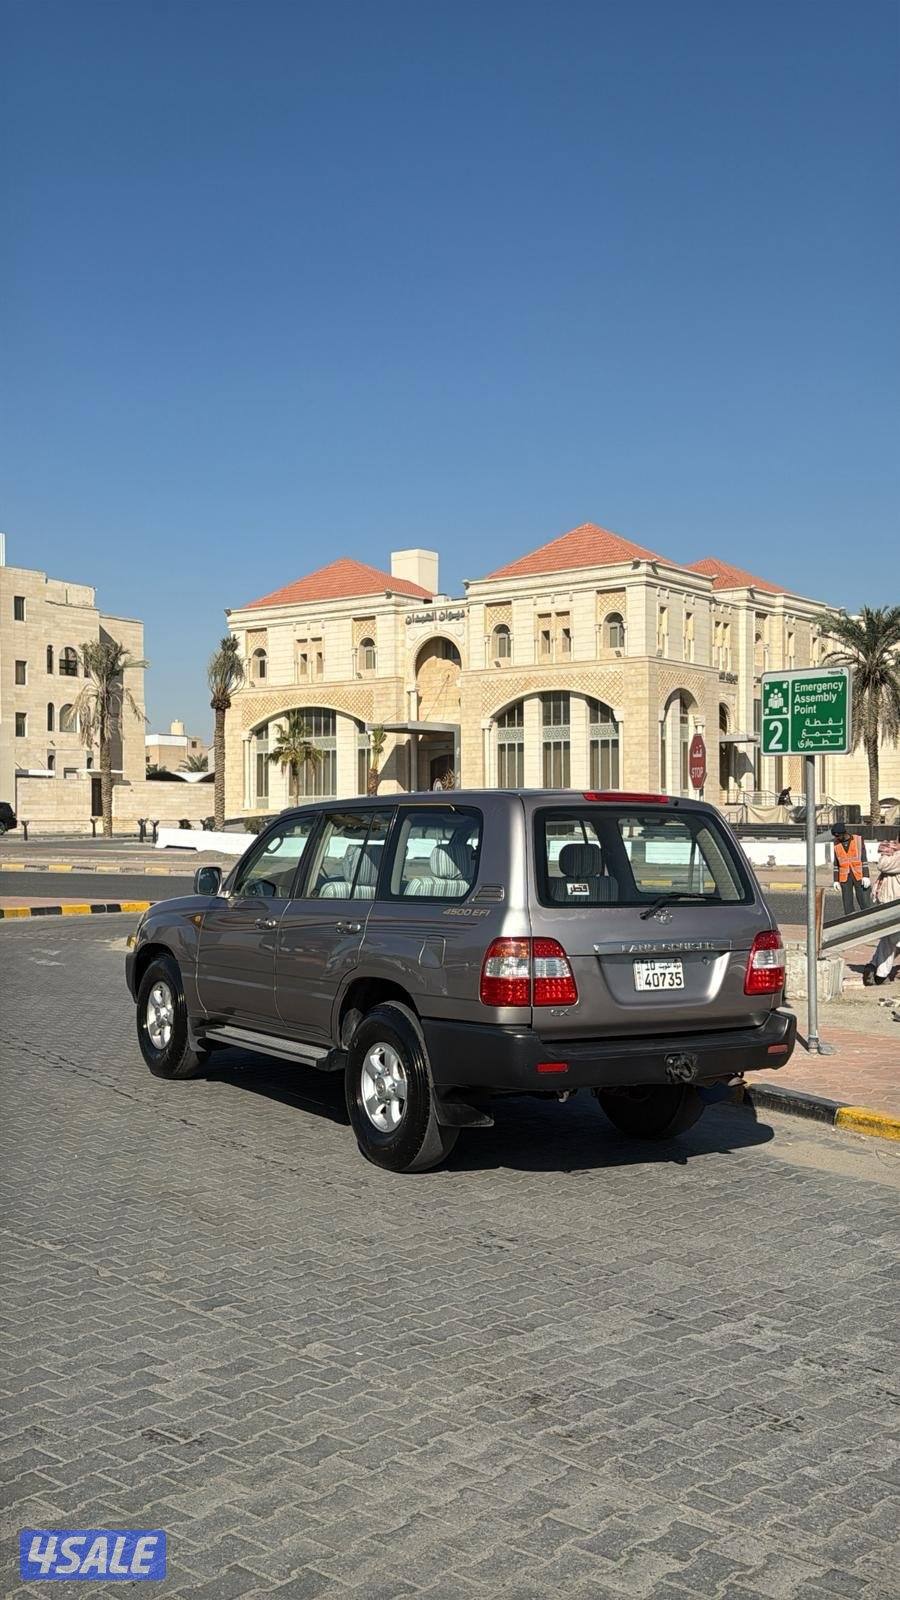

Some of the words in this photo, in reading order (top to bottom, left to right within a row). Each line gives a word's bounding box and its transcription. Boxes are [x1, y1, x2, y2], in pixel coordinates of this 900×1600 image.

[794, 681, 844, 693] Emergency
[794, 691, 837, 703] Assembly
[794, 704, 817, 715] Point
[768, 720, 783, 750] 2
[691, 766, 704, 779] STOP
[471, 908, 491, 917] EFI
[644, 971, 683, 988] 40735
